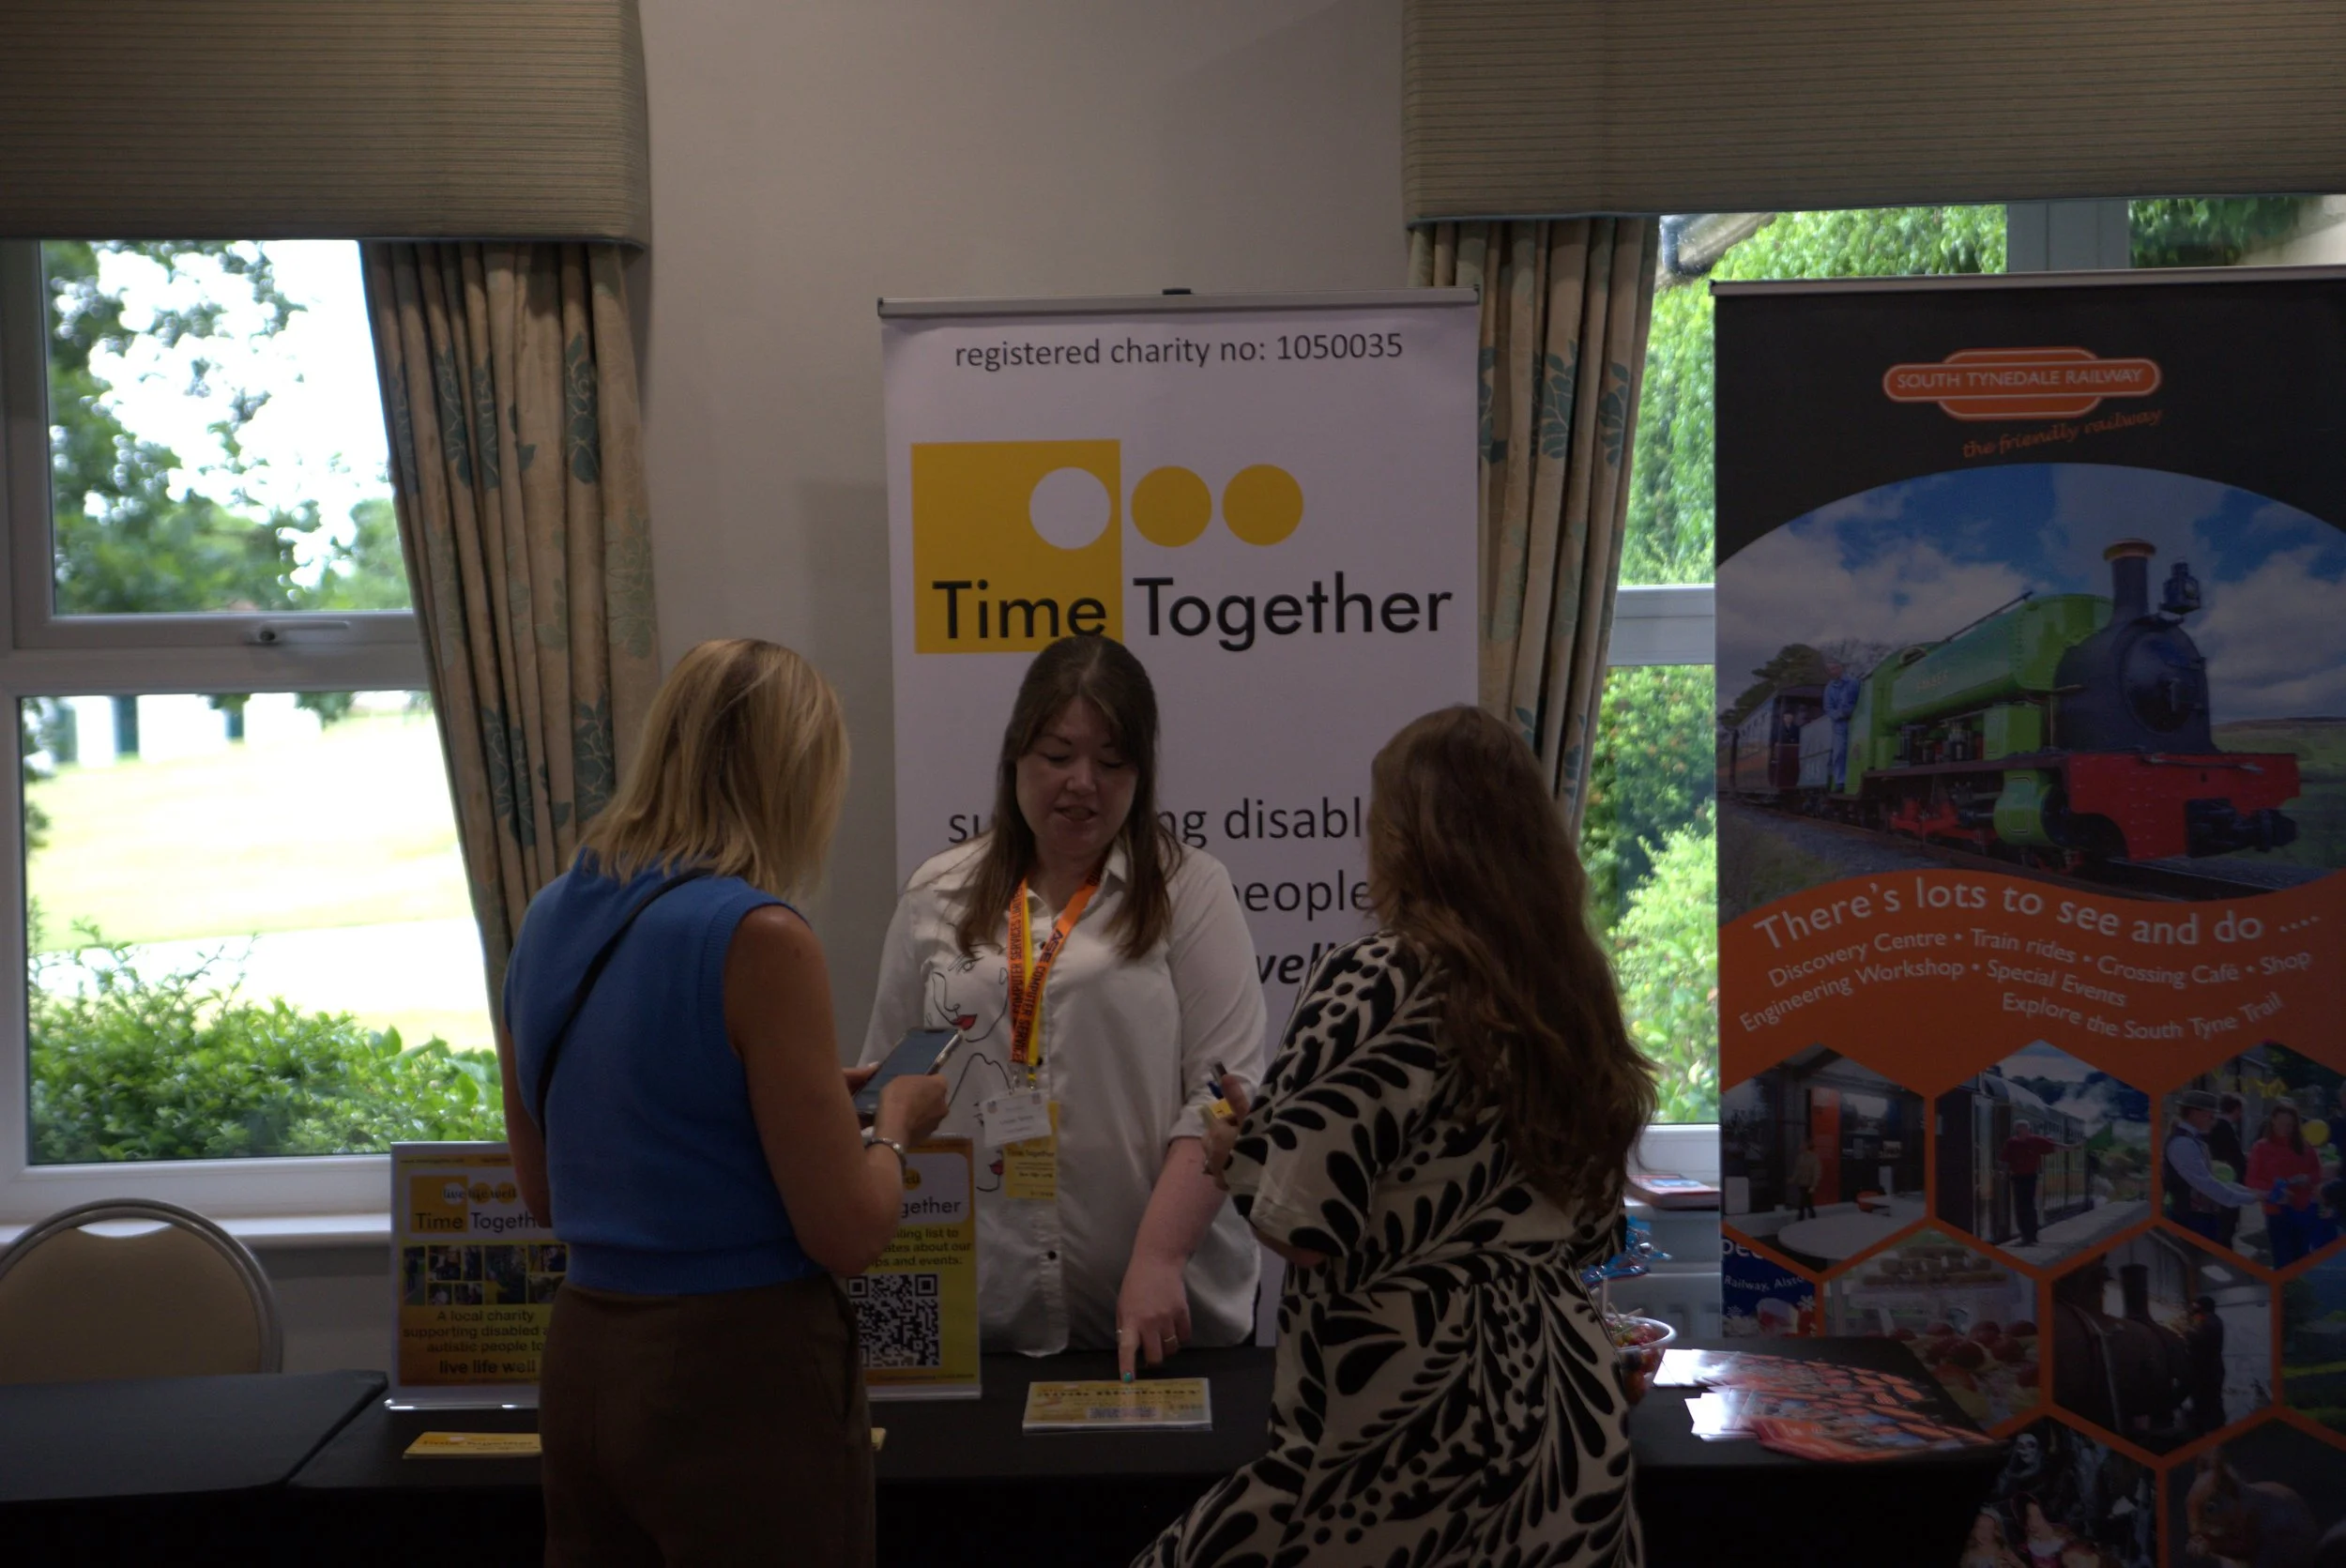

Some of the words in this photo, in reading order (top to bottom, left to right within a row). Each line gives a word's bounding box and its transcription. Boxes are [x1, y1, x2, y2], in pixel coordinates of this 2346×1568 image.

[955, 337, 1100, 372] registered
[1111, 336, 1210, 368] charity
[1220, 341, 1265, 361] no:
[1277, 332, 1403, 360] 1050035
[1897, 373, 1960, 388] SOUTH
[1967, 370, 2060, 387] TYNEDALE
[2065, 368, 2144, 385] RAILWAY
[1961, 440, 1995, 458] the
[1999, 423, 2079, 454] friendly
[2083, 409, 2163, 434] railway
[932, 579, 1106, 638] Time
[1134, 571, 1453, 651] Together
[1225, 796, 1361, 839] disabl
[1233, 870, 1370, 921] eople
[1753, 882, 1901, 949] There's
[1916, 875, 1988, 910] lots
[2002, 884, 2044, 917] to
[2057, 898, 2121, 936] see
[2131, 912, 2199, 945] and
[2213, 909, 2263, 942] do
[1010, 919, 1022, 961] SERVICES
[1768, 942, 1868, 988] Discovery
[1874, 932, 1946, 952] Centre
[1971, 928, 2020, 951] Train
[2026, 938, 2077, 965] rides
[2096, 954, 2187, 990] Crossing
[2192, 964, 2240, 984] Café
[2260, 951, 2312, 977] Shop
[1739, 976, 1854, 1033] Engineering
[1854, 958, 1965, 986] Workshop
[1987, 959, 2055, 984] Special
[2062, 974, 2127, 1008] Events
[2003, 992, 2081, 1025] Explore
[2086, 1013, 2119, 1036] the
[2124, 1019, 2184, 1040] South
[2188, 1015, 2239, 1043] Tyne
[2238, 992, 2284, 1024] Trail
[415, 1212, 465, 1229] Time
[470, 1211, 537, 1233] Togeth
[901, 1196, 961, 1219] gether
[913, 1241, 949, 1253] about
[952, 1242, 971, 1252] our
[925, 1227, 943, 1239] list
[947, 1227, 959, 1239] to
[892, 1255, 916, 1266] and
[403, 1326, 478, 1339] supporting
[481, 1324, 540, 1337] disabled
[436, 1310, 447, 1321] A
[450, 1310, 482, 1321] local
[487, 1310, 535, 1323] charity
[426, 1341, 478, 1352] autistic
[480, 1340, 527, 1354] people
[439, 1359, 467, 1374] live
[473, 1359, 497, 1374] life
[502, 1359, 536, 1374] well
